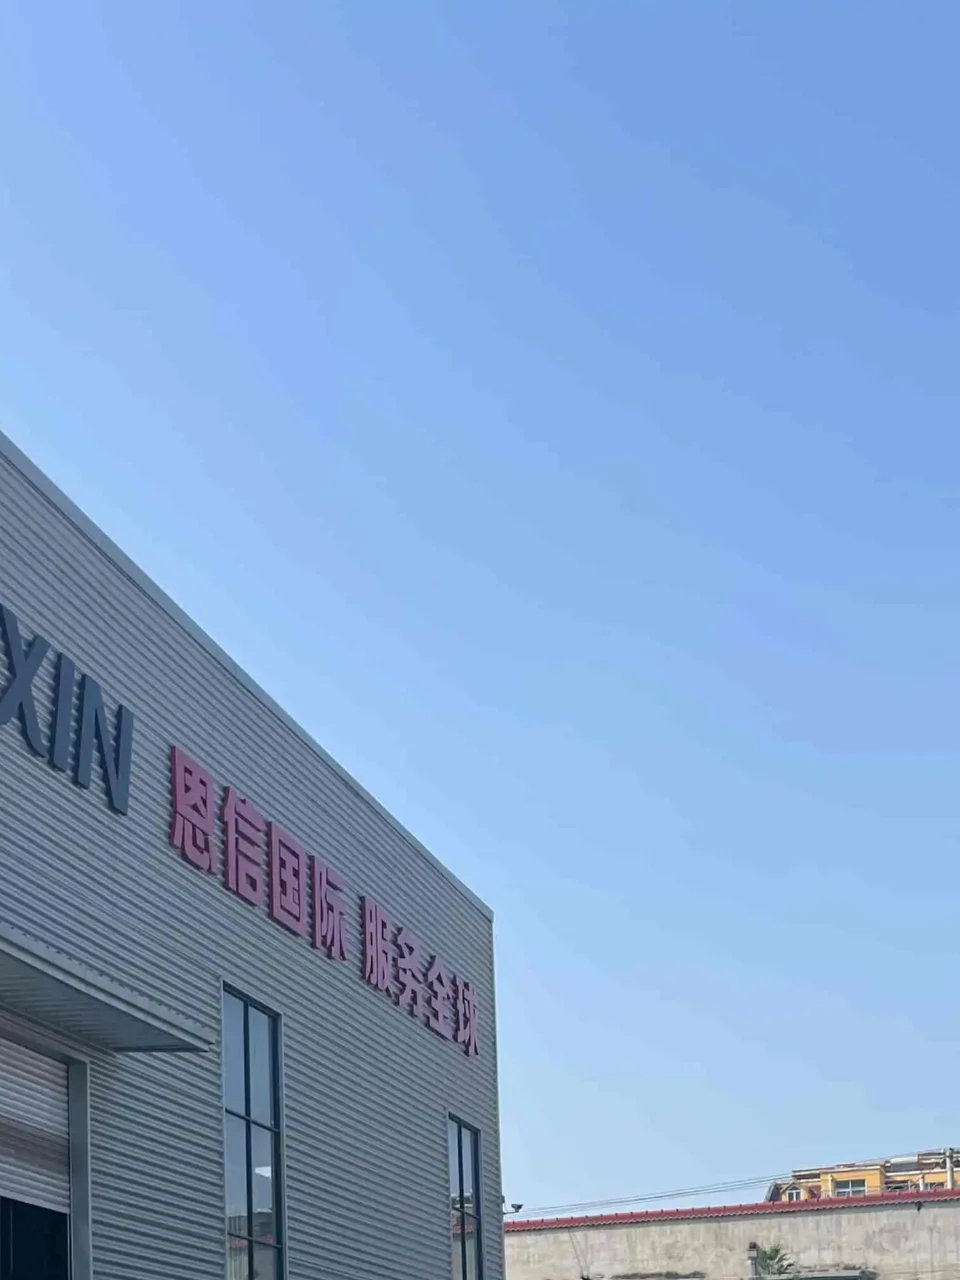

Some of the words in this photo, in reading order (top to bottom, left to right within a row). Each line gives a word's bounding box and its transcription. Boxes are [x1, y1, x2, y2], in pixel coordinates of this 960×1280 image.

[170, 745, 347, 961] 恩信国际
[360, 895, 479, 1057] 服务全球
